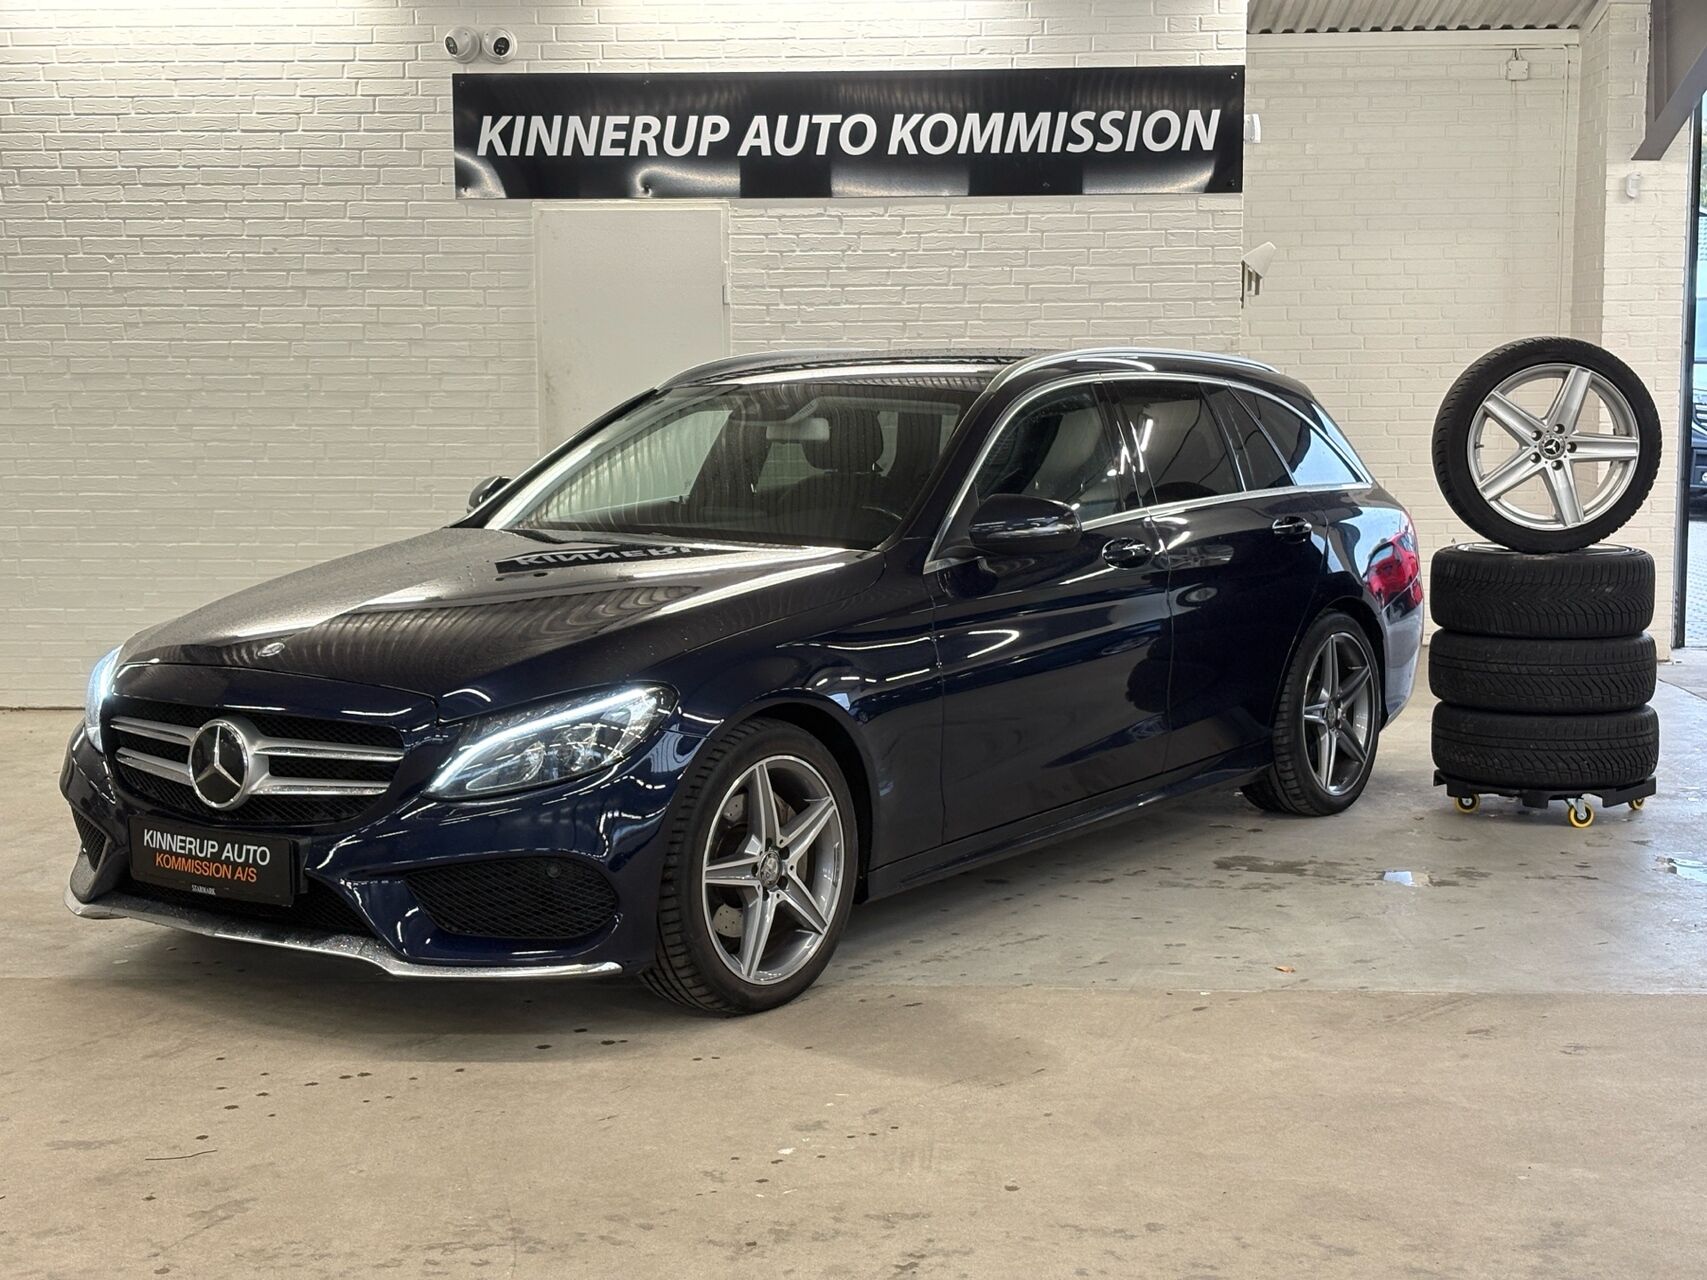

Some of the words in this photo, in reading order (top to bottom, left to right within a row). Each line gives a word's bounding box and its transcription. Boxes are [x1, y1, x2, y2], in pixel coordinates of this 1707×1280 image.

[477, 115, 730, 157] KINNERUP
[737, 114, 877, 157] AUTO
[887, 109, 1220, 155] KOMMISSION
[143, 829, 219, 859] KINNERUP
[221, 842, 271, 866] AUTO
[156, 852, 232, 880] KOMMISSION
[234, 867, 257, 883] A/S
